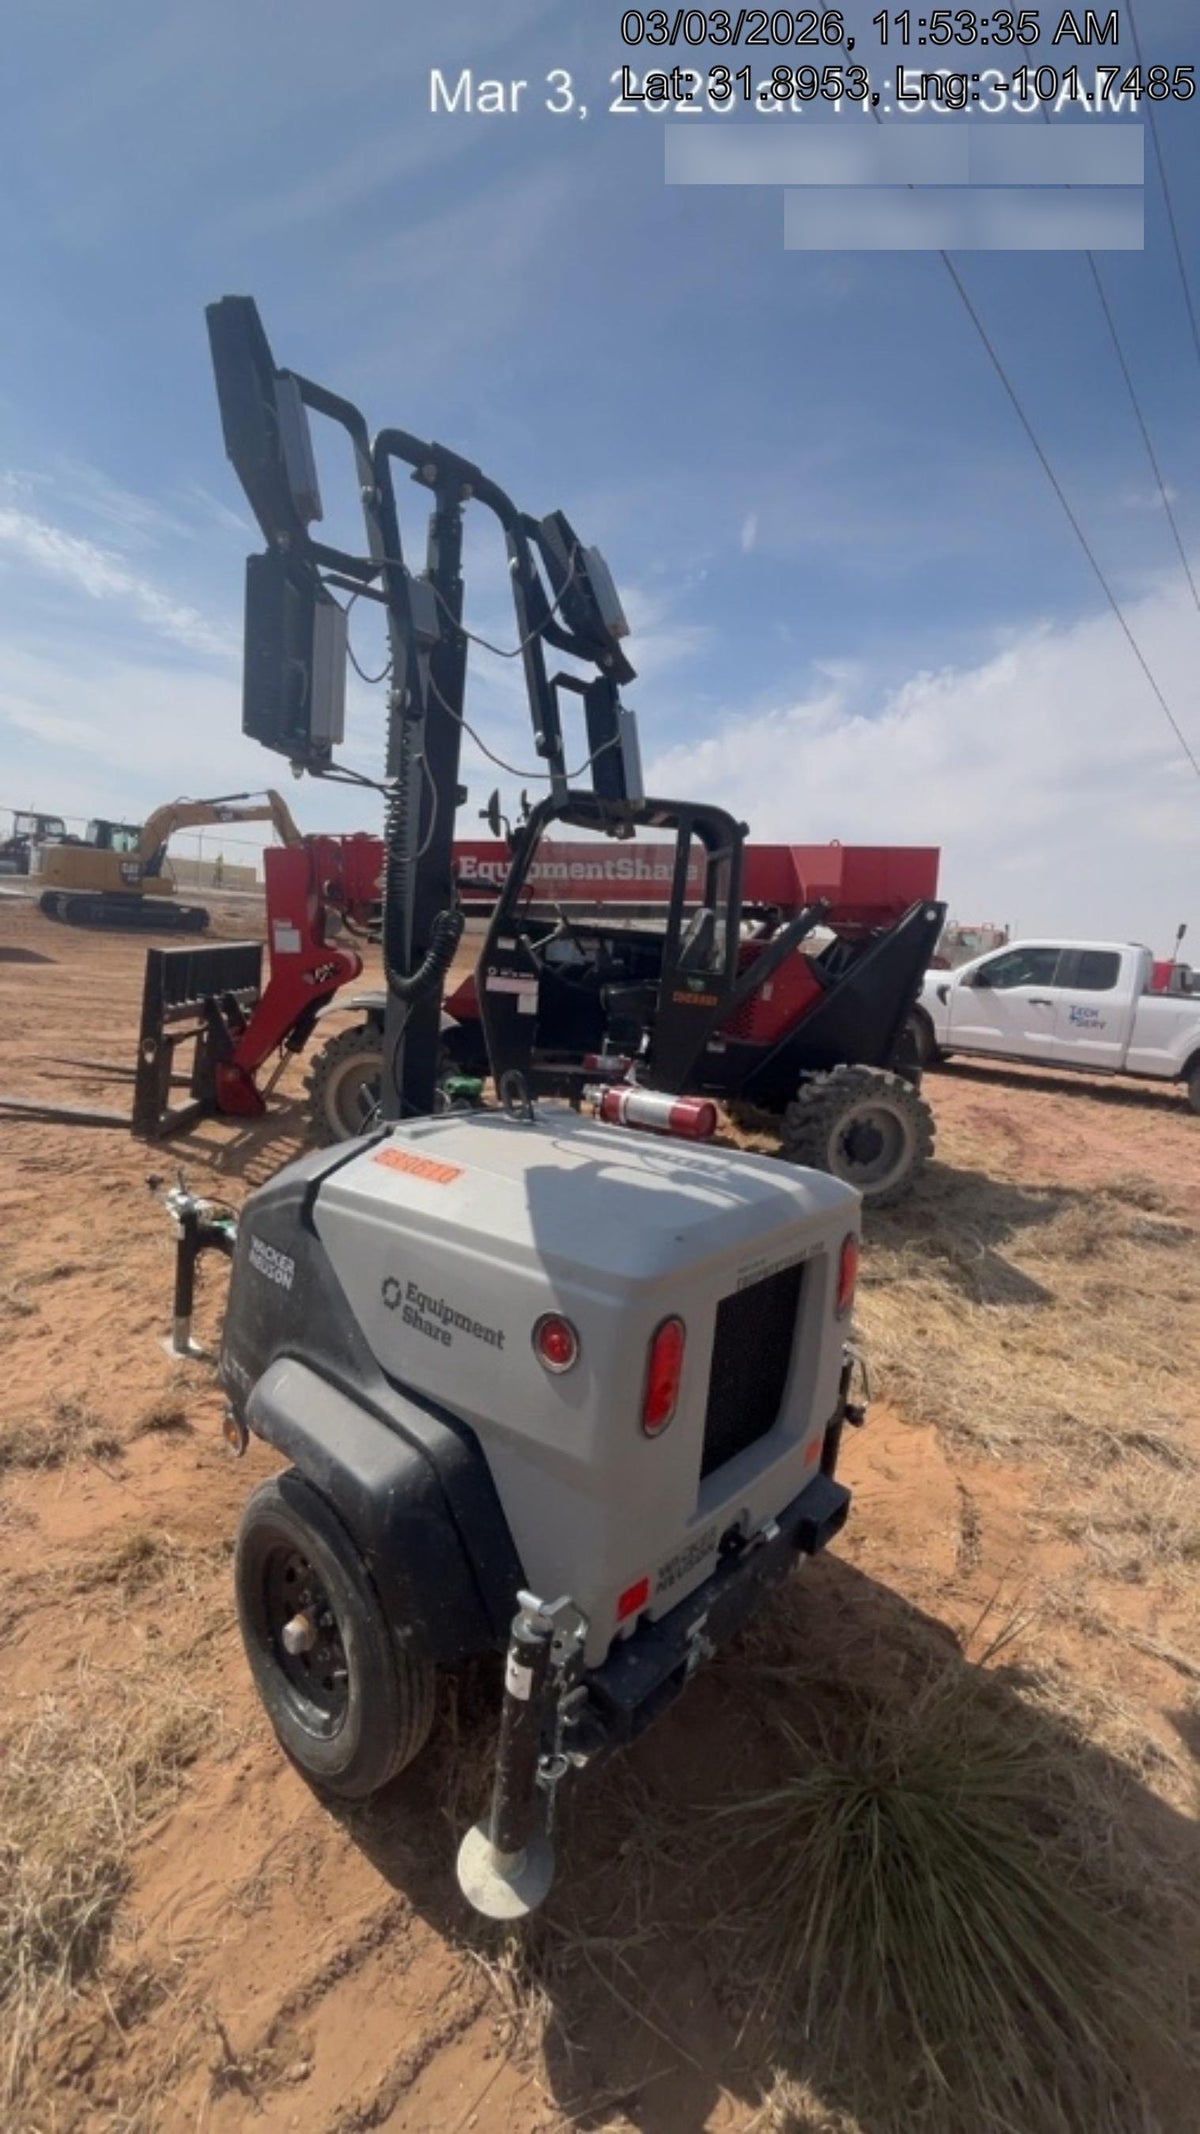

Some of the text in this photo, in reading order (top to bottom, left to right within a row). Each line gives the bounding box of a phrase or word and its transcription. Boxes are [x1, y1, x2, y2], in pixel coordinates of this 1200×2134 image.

[1069, 1004, 1099, 1019] TECH
[402, 1304, 452, 1347] Share
[405, 1281, 506, 1350] Equipment
